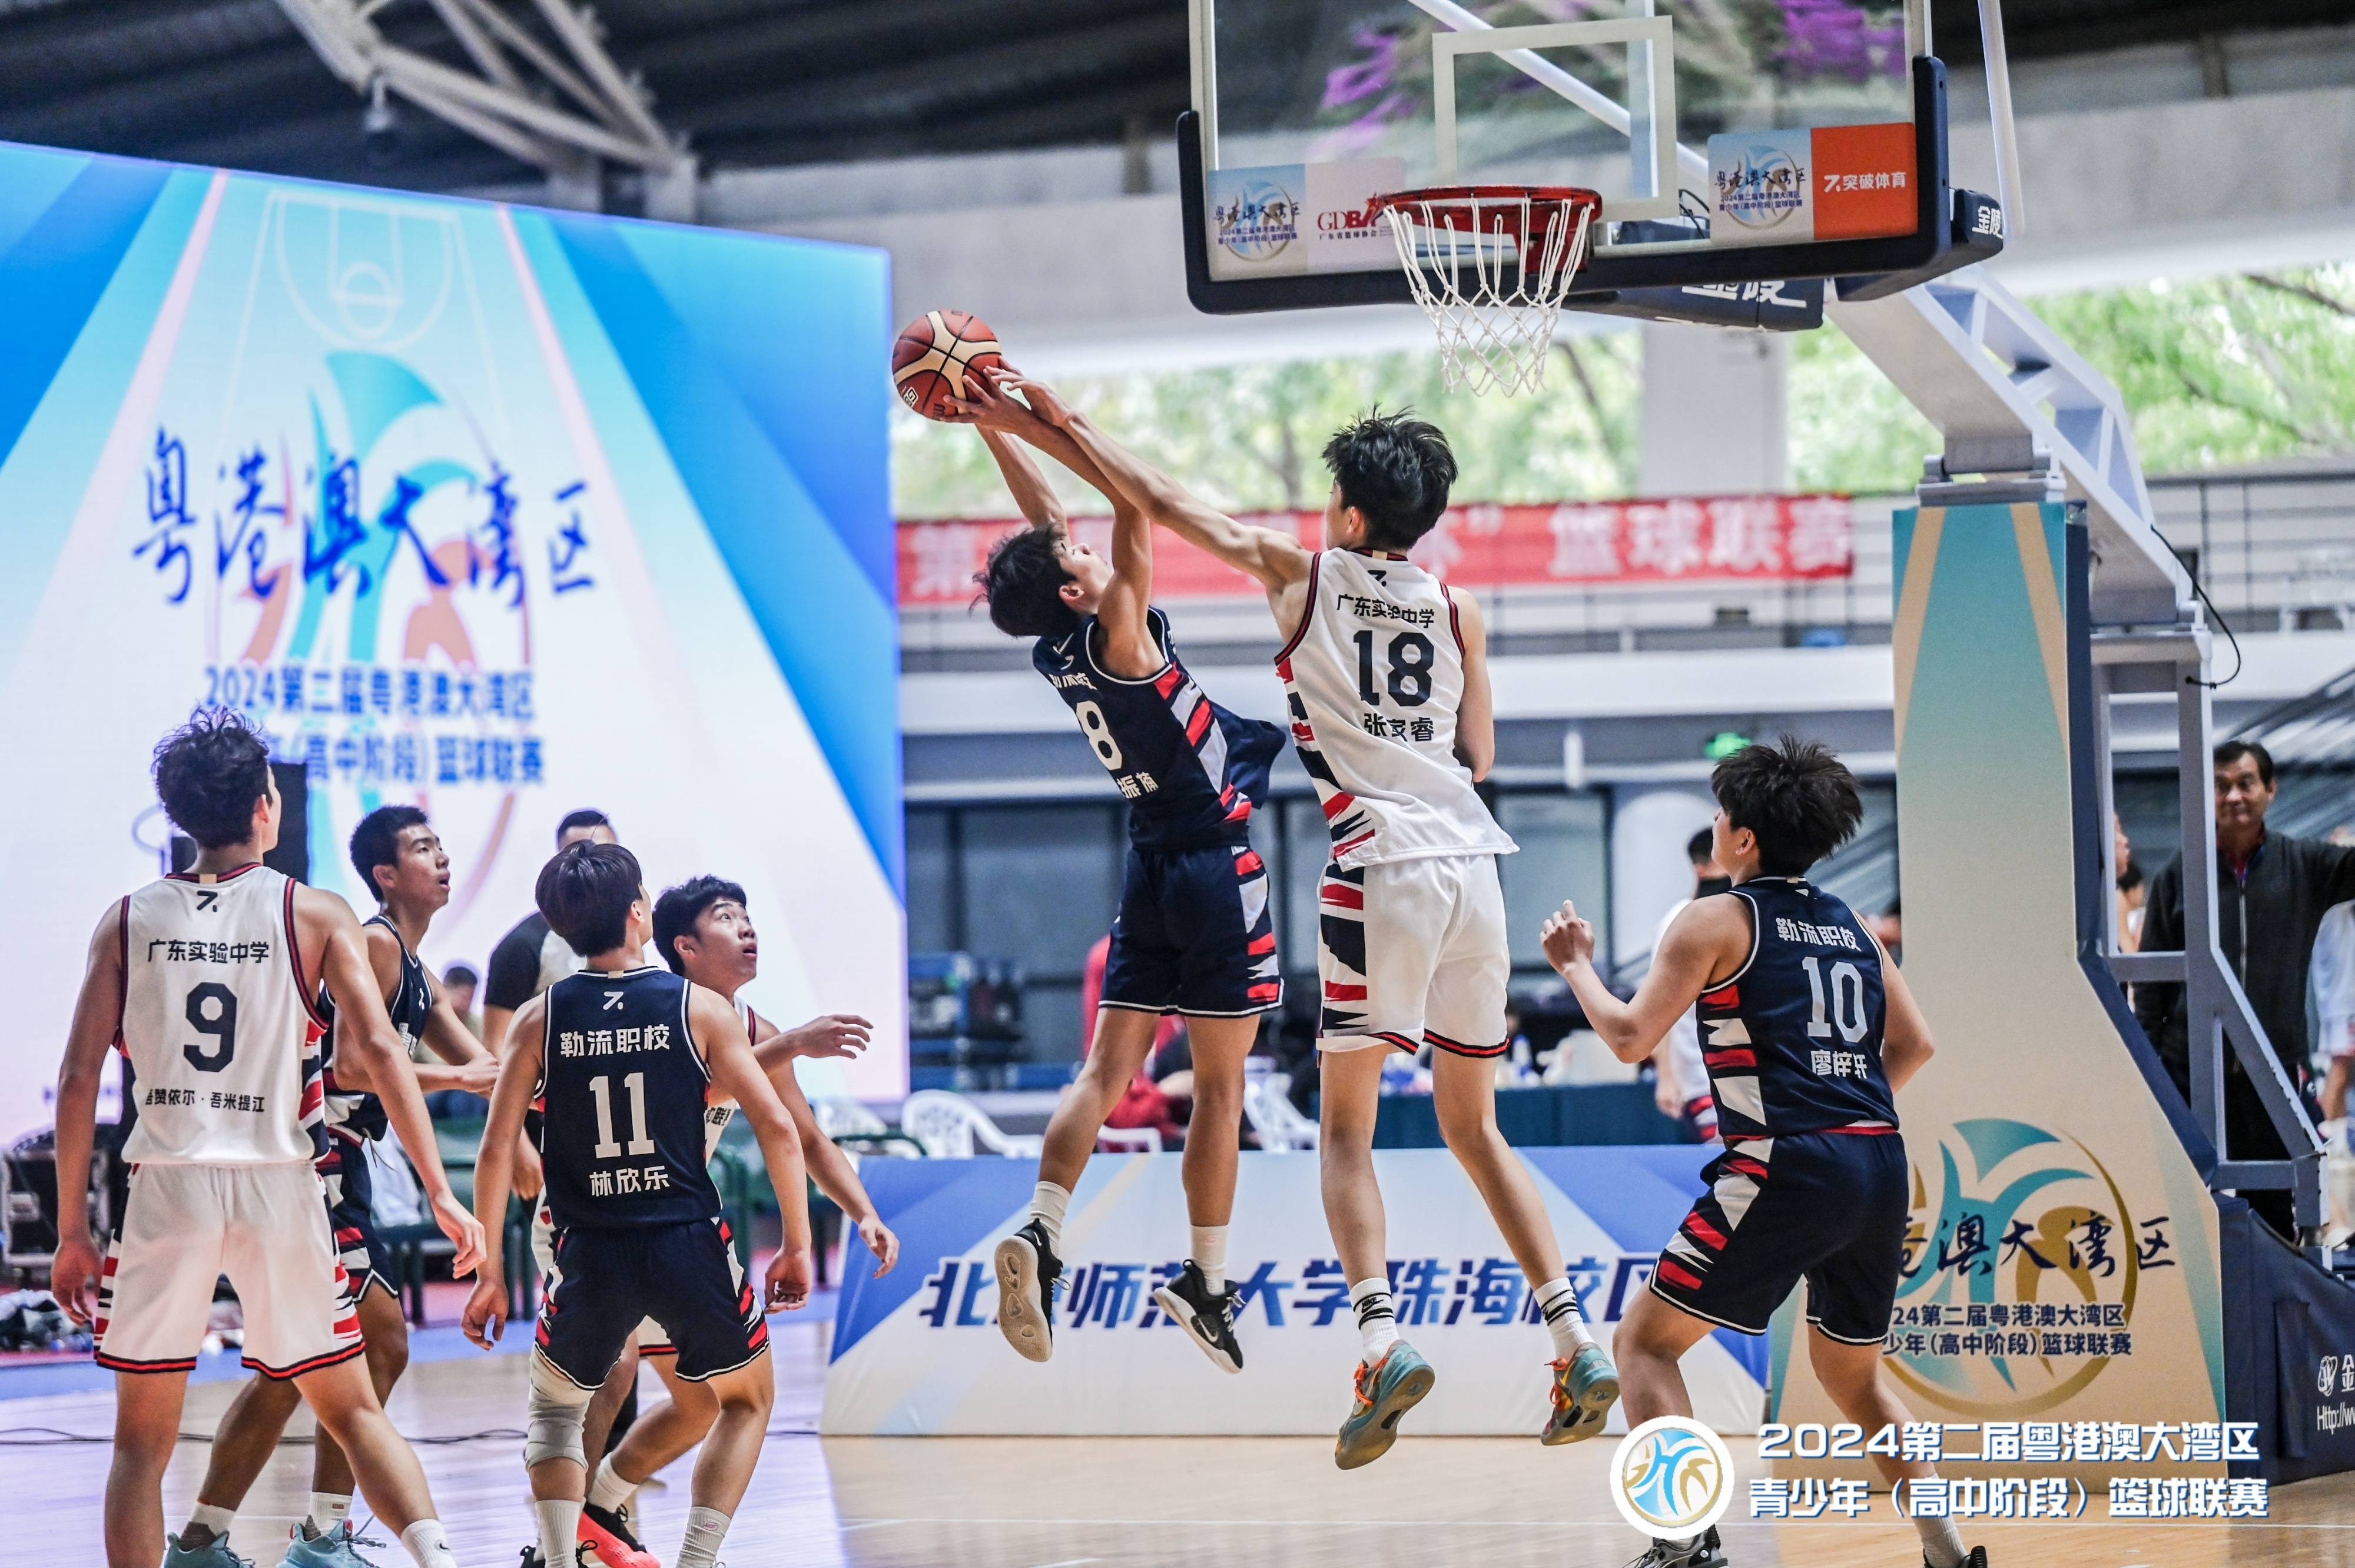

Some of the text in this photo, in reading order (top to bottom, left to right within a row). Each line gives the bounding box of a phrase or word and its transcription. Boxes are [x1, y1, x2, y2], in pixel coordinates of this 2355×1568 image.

[1843, 171, 1907, 191] 突破体育
[1972, 205, 2003, 239] 金陵
[130, 427, 596, 610] 粤港澳大湾区
[1336, 594, 1435, 629] 广东实验中学
[1354, 630, 1435, 707] 18
[1076, 700, 1122, 770] 8
[147, 938, 270, 964] 广东实验中学
[1775, 917, 1862, 952] 勒流职校
[1802, 956, 1868, 1043] 10
[184, 982, 238, 1073] 9
[560, 1024, 671, 1058] 勒流职校
[589, 1072, 655, 1159] 11
[589, 1165, 671, 1197] 林欣乐
[1361, 1297, 1377, 1308] NIKE
